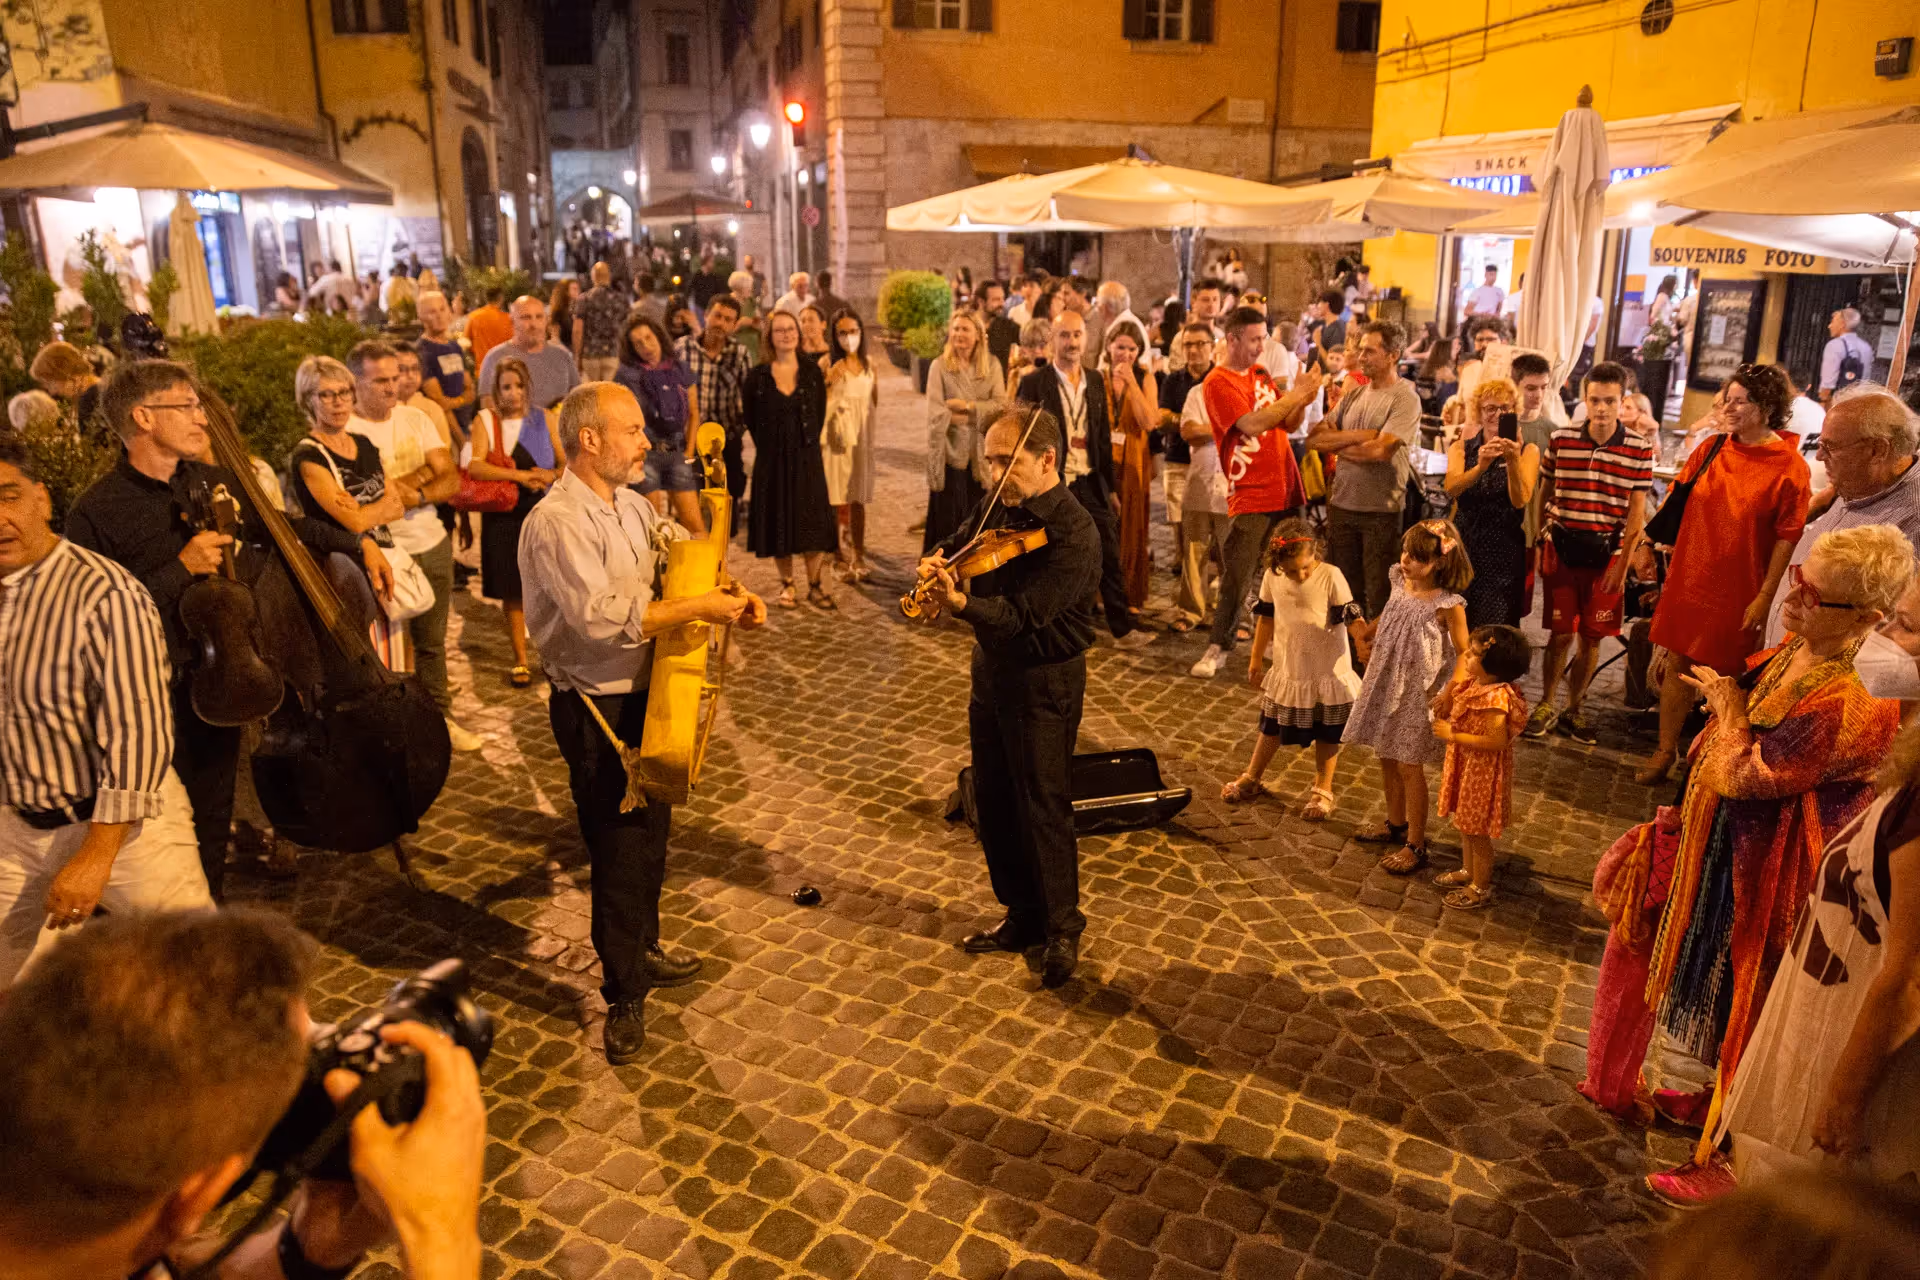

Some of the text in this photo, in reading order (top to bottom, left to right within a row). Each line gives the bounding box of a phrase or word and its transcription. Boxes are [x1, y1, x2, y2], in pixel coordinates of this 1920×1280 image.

[1475, 156, 1527, 171] SNACK
[1654, 247, 1815, 267] SOUVENIRS FOTO
